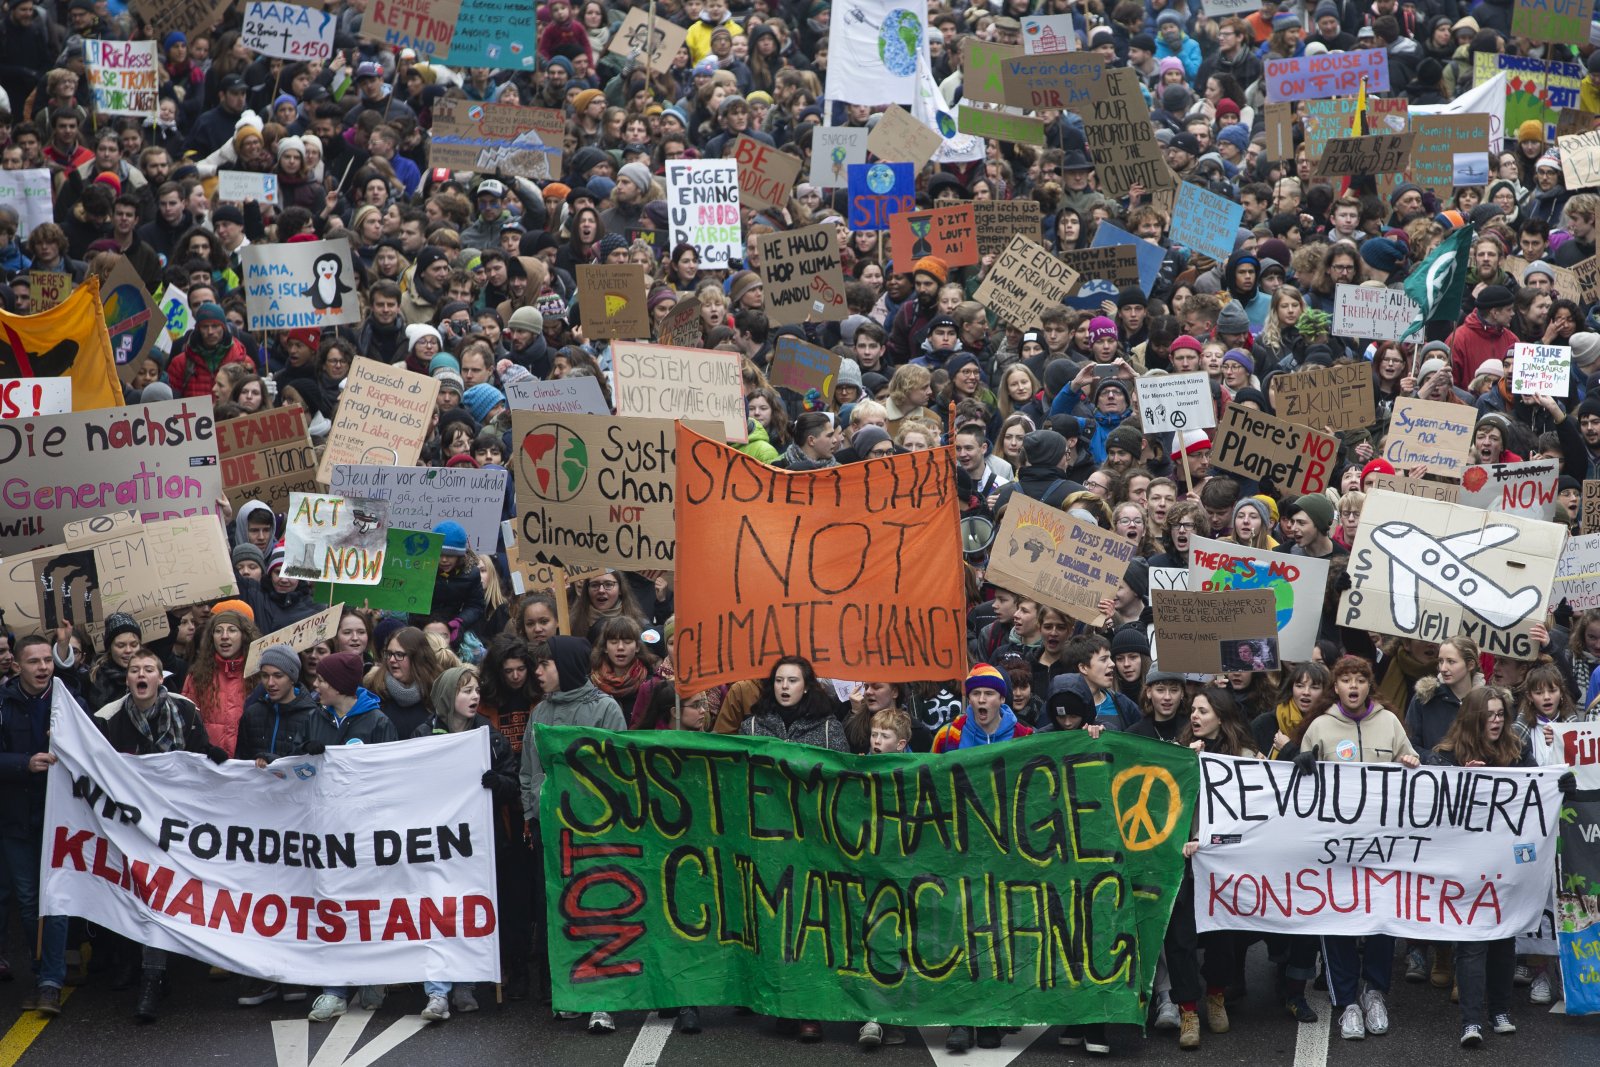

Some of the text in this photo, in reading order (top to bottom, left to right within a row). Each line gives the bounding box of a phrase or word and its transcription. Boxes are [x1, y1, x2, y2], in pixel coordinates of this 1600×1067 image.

[290, 40, 330, 58] 2150
[1267, 50, 1385, 78] OUR HOUSE IS
[1031, 89, 1063, 107] DIR
[1280, 78, 1306, 97] ON
[1092, 101, 1130, 123] YOUR
[735, 137, 776, 175] BE
[678, 185, 739, 206] ENANG
[853, 194, 915, 228] STOP
[697, 204, 740, 226] NID
[763, 230, 829, 261] HE HALLO
[998, 252, 1019, 270] IST
[1009, 236, 1035, 259] DIE
[1030, 250, 1073, 286] ERDE
[1064, 247, 1117, 263] SNOW IS
[766, 261, 795, 284] HOP
[989, 267, 1028, 302] WARUM
[41, 286, 60, 301] NO
[249, 281, 276, 299] WAS
[770, 274, 845, 307] WANDU STOP
[989, 287, 1037, 324] EIGENTLICH
[1536, 346, 1563, 359] SURE
[620, 353, 695, 385] SYSTEM
[698, 361, 742, 388] CHANGE
[1346, 364, 1367, 384] DIE
[512, 384, 532, 400] The
[620, 386, 748, 418] NOT CLIMATE CHANGE
[1284, 384, 1367, 417] ZUKUNFT
[344, 398, 372, 420] frag
[1307, 410, 1353, 432] KLAUT
[85, 402, 214, 453] nächste
[232, 406, 306, 447] FAHRT
[1227, 406, 1336, 462] There's NO
[1417, 429, 1439, 445] not
[220, 452, 261, 488] DIE
[258, 445, 316, 479] Titanic
[371, 468, 391, 487] dir
[395, 471, 417, 486] vor
[1300, 460, 1325, 496] B
[2, 460, 203, 511] Generation
[1501, 477, 1560, 511] NOW
[292, 496, 345, 529] ACT
[437, 507, 474, 519] schad
[608, 503, 645, 524] NOT
[522, 506, 611, 554] Climate
[322, 545, 384, 582] NOW
[733, 514, 930, 605] NOT
[1193, 549, 1301, 583] THERE'S NO
[1345, 548, 1373, 626] STOP
[292, 612, 330, 635] ACTION
[676, 600, 833, 686] CLIMATE
[1200, 755, 1549, 838] REVOLUTIONIERÄ
[158, 815, 358, 870] FORDERN
[372, 821, 475, 868] DEN
[1317, 835, 1433, 866] STATT
[50, 825, 498, 943] KLIMANOTSTAND
[1207, 865, 1504, 926] KONSUMIERÄ
[557, 826, 649, 987] NOT
